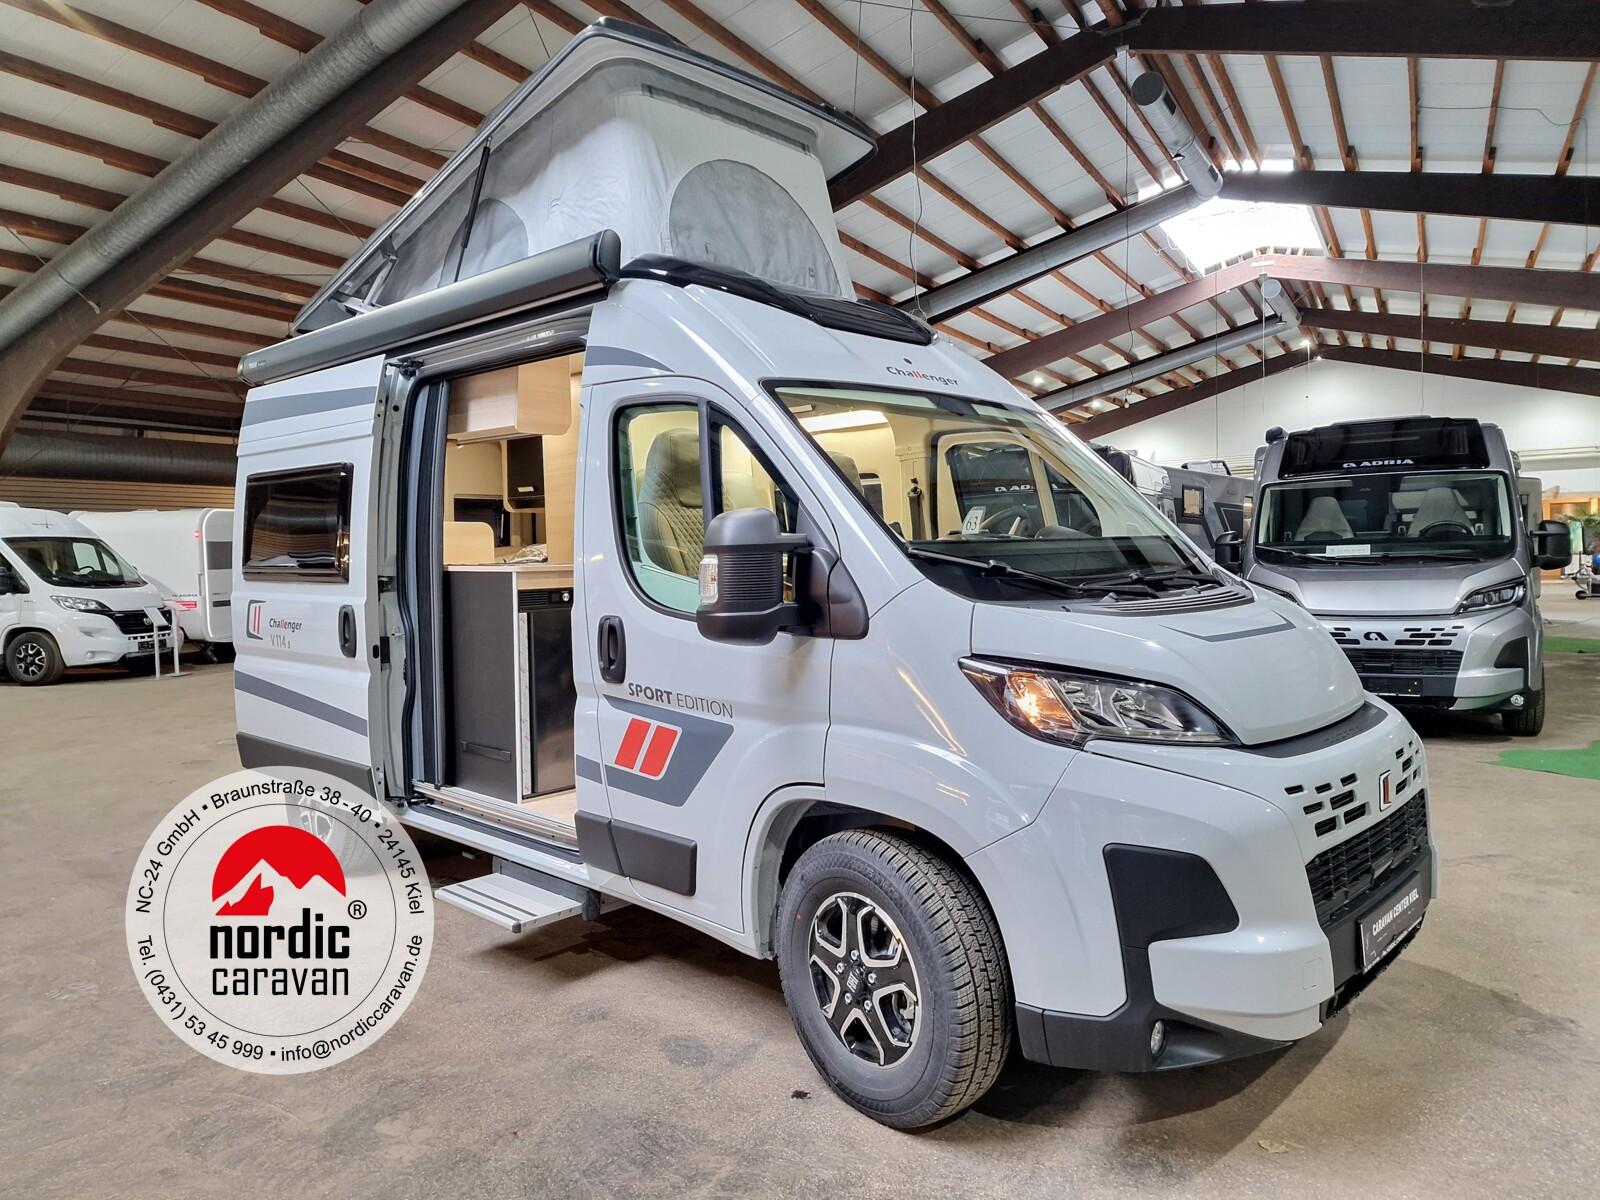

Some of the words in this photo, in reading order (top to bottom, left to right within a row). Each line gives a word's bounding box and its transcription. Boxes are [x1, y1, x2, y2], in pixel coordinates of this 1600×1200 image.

[886, 365, 959, 386] Challenger
[1360, 459, 1415, 467] ADRIA
[268, 617, 303, 633] Challenger
[628, 682, 673, 705] SPORT
[676, 693, 733, 719] EDITION
[1393, 895, 1410, 918] CENTER
